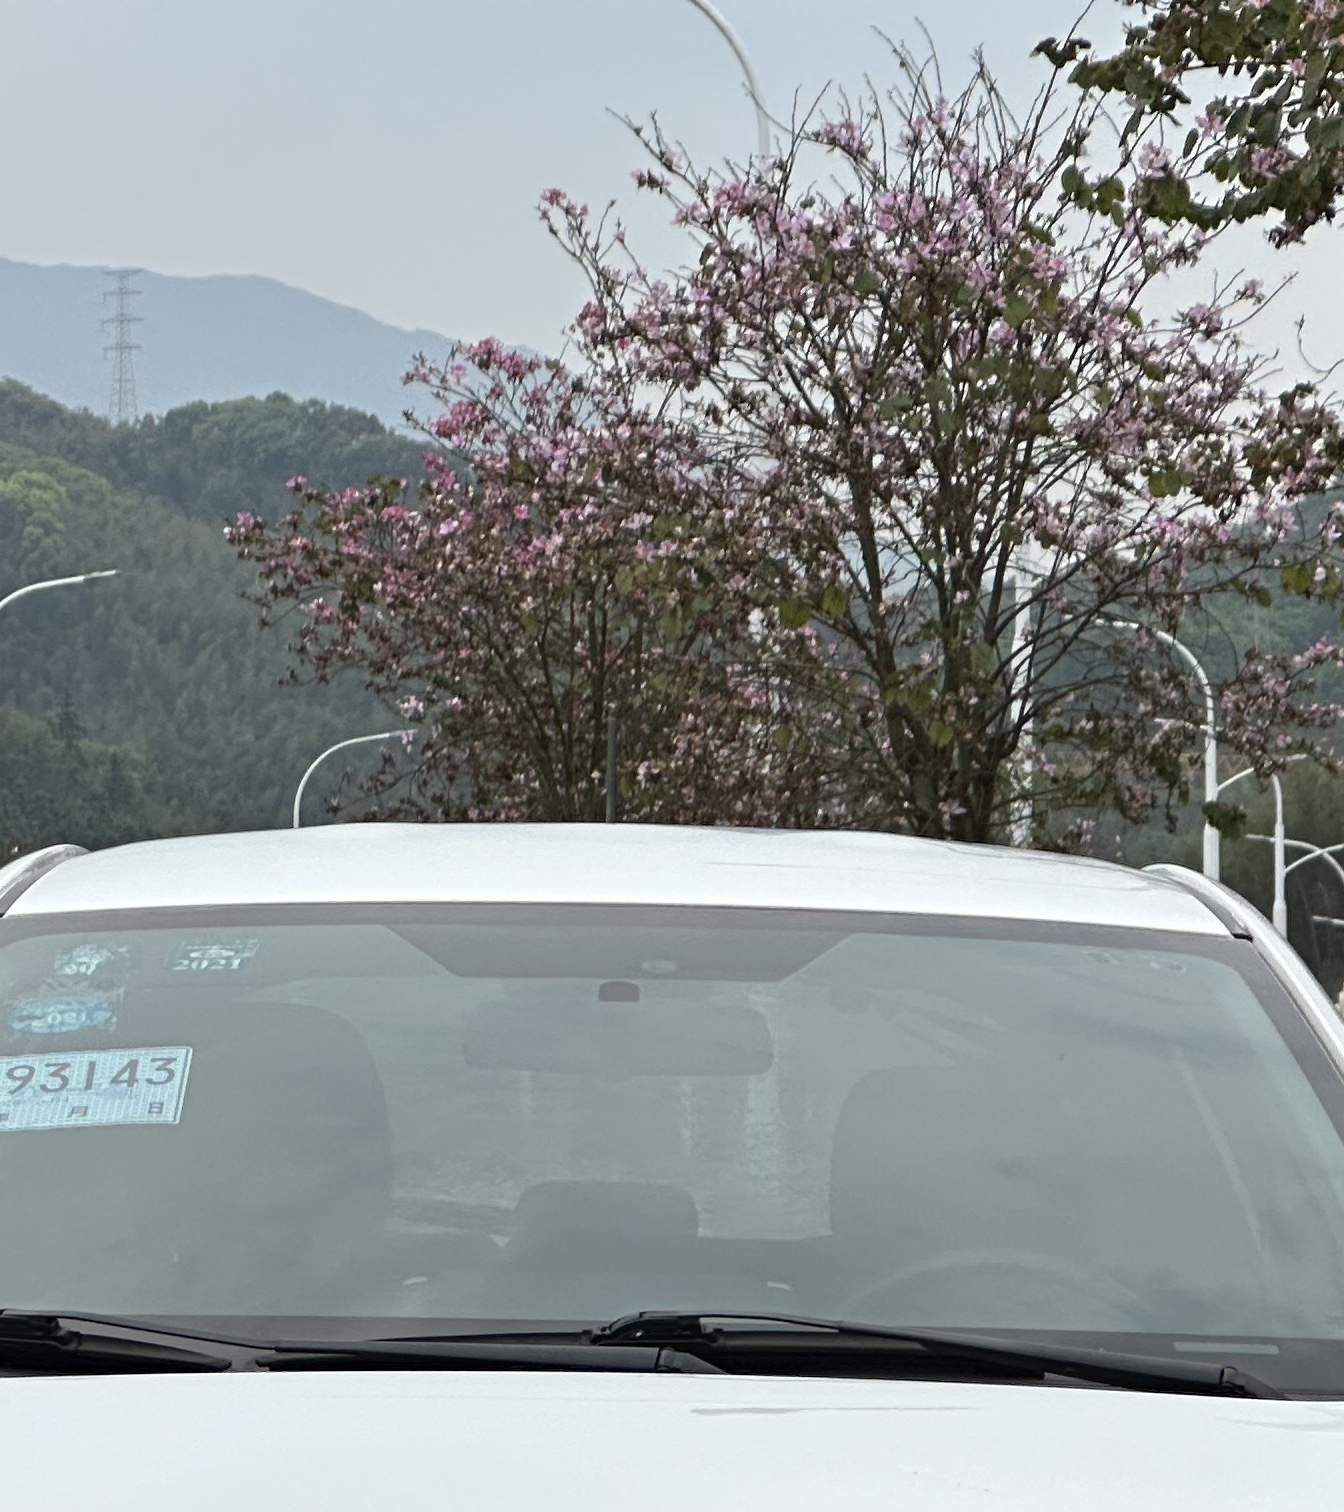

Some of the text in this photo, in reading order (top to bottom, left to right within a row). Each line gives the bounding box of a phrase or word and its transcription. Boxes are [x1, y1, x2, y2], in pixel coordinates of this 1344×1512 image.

[171, 957, 242, 972] 2021
[66, 1105, 89, 1119] 月
[147, 1102, 165, 1115] 日
